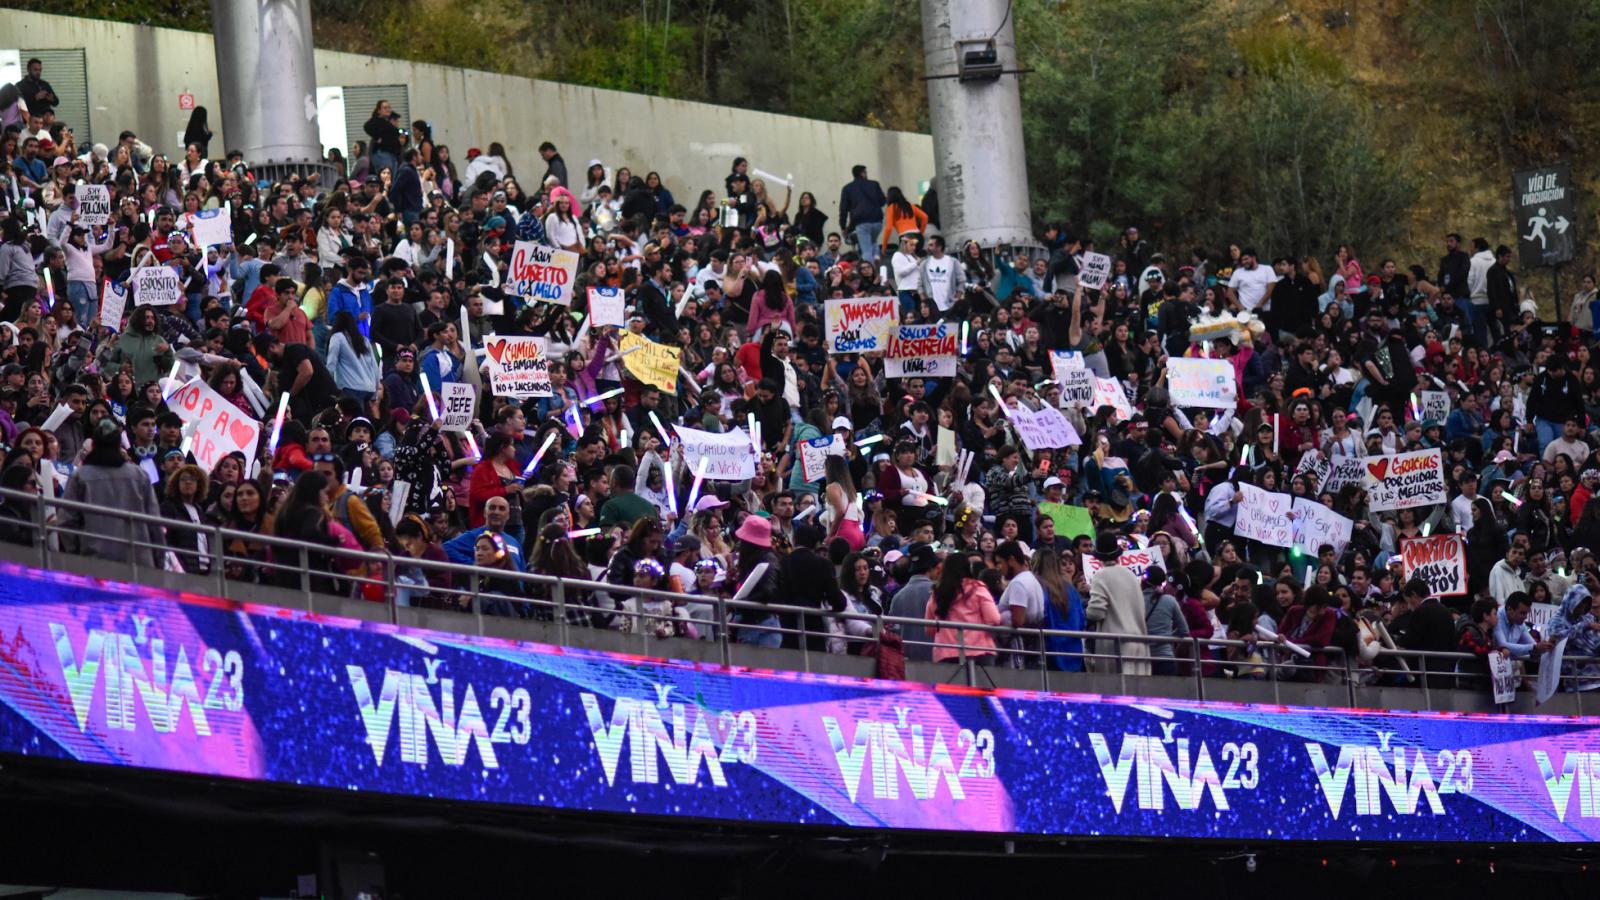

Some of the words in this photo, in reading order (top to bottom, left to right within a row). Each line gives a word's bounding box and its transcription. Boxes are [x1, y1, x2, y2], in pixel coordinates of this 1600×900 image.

[1522, 186, 1565, 206] EVACUACIÓN
[1528, 173, 1543, 192] VÍA
[1545, 173, 1557, 189] DE
[501, 361, 512, 373] TE
[496, 383, 507, 393] NO
[447, 397, 472, 413] JEFE
[1383, 474, 1404, 490] POR
[203, 649, 244, 712] 23
[490, 688, 532, 745] 23
[720, 710, 757, 763] 23
[957, 729, 996, 779] 23
[1221, 742, 1259, 789] 23
[1437, 749, 1474, 794] 23
